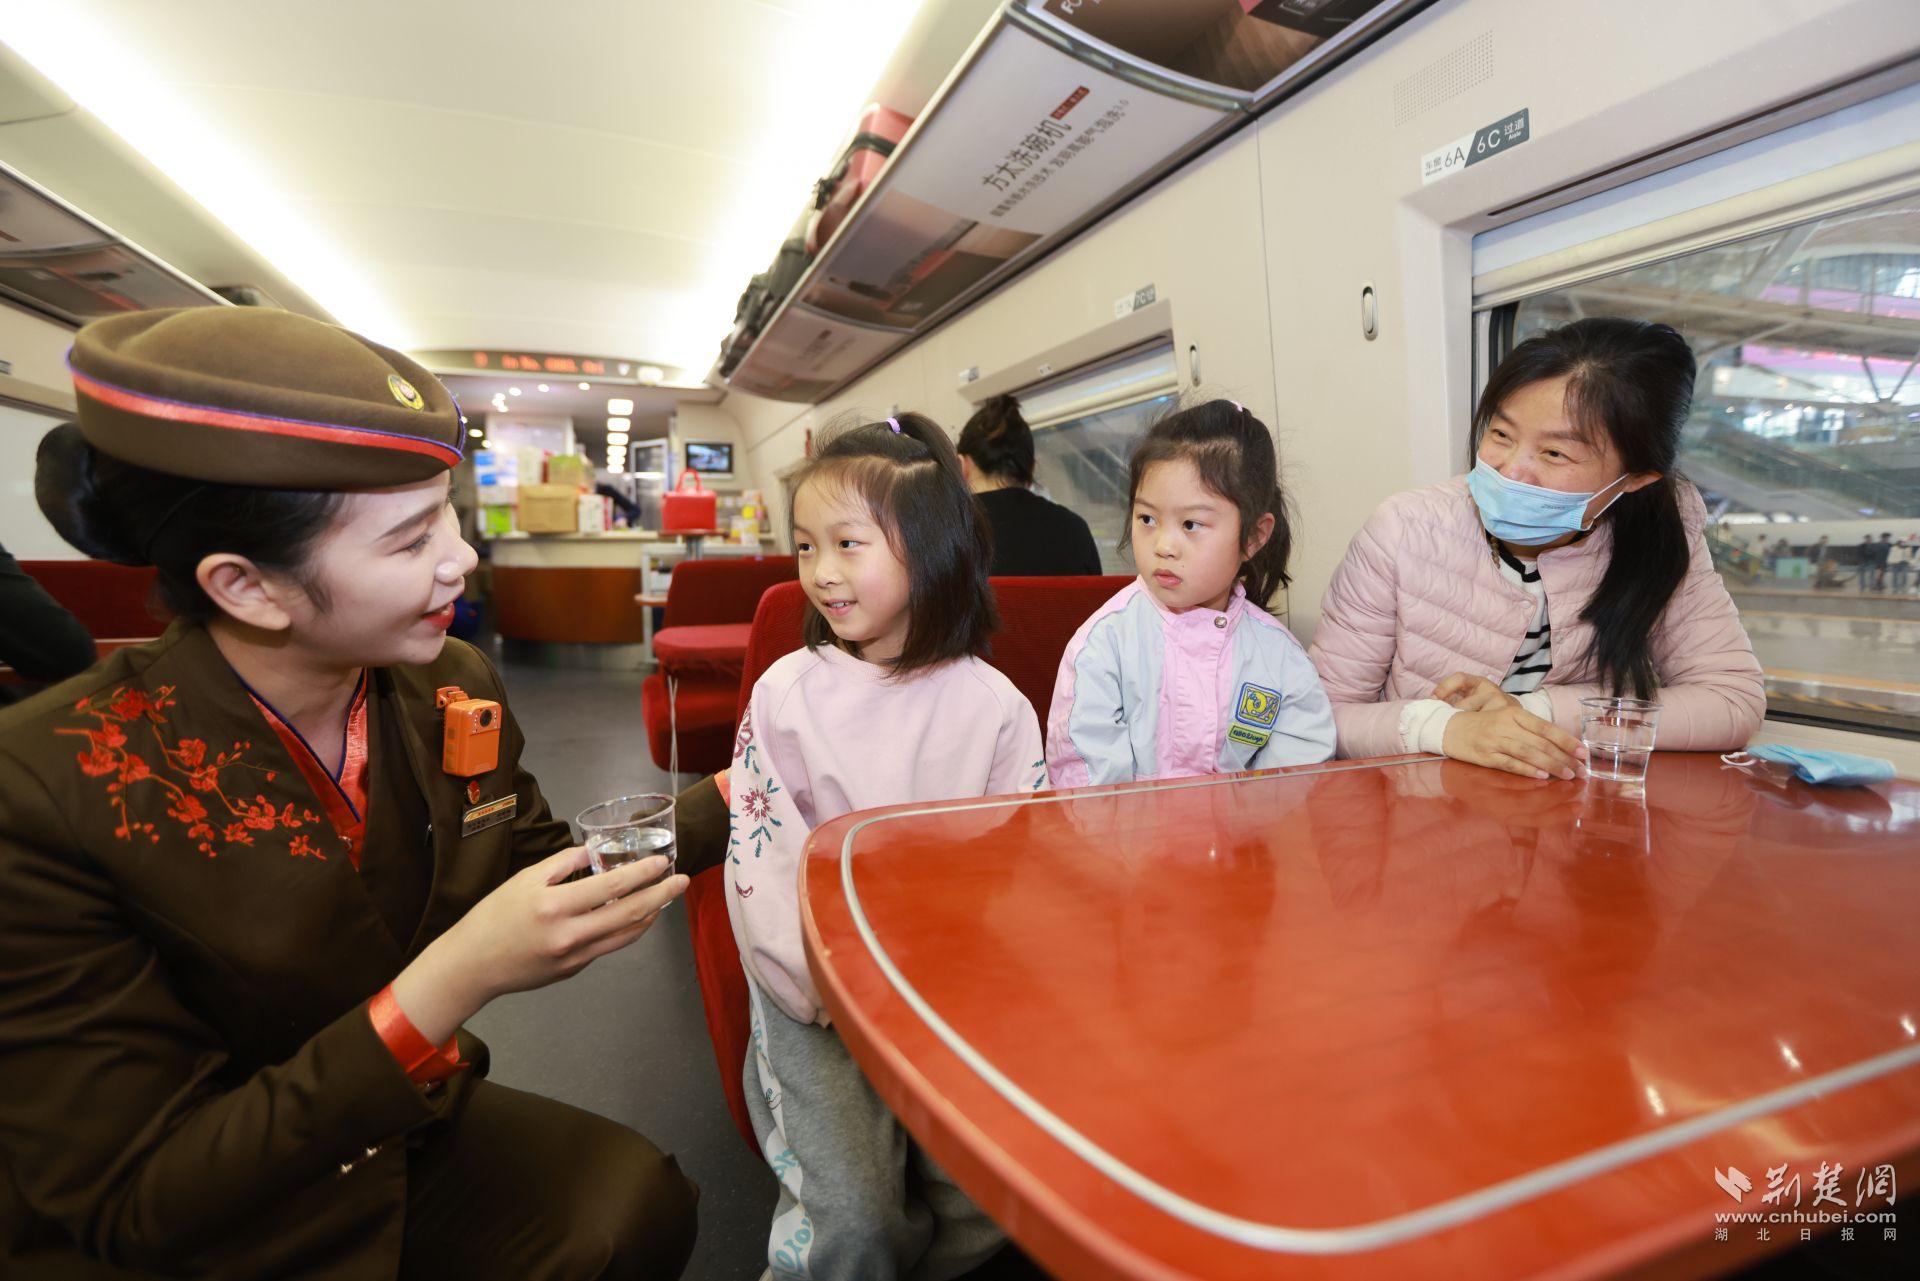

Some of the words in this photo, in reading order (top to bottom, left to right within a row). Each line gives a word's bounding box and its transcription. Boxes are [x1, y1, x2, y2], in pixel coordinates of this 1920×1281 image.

[1504, 117, 1525, 135] 过道
[982, 117, 1071, 192] 方太洗碗机
[1444, 146, 1465, 168] 6A
[1477, 129, 1501, 154] 6C
